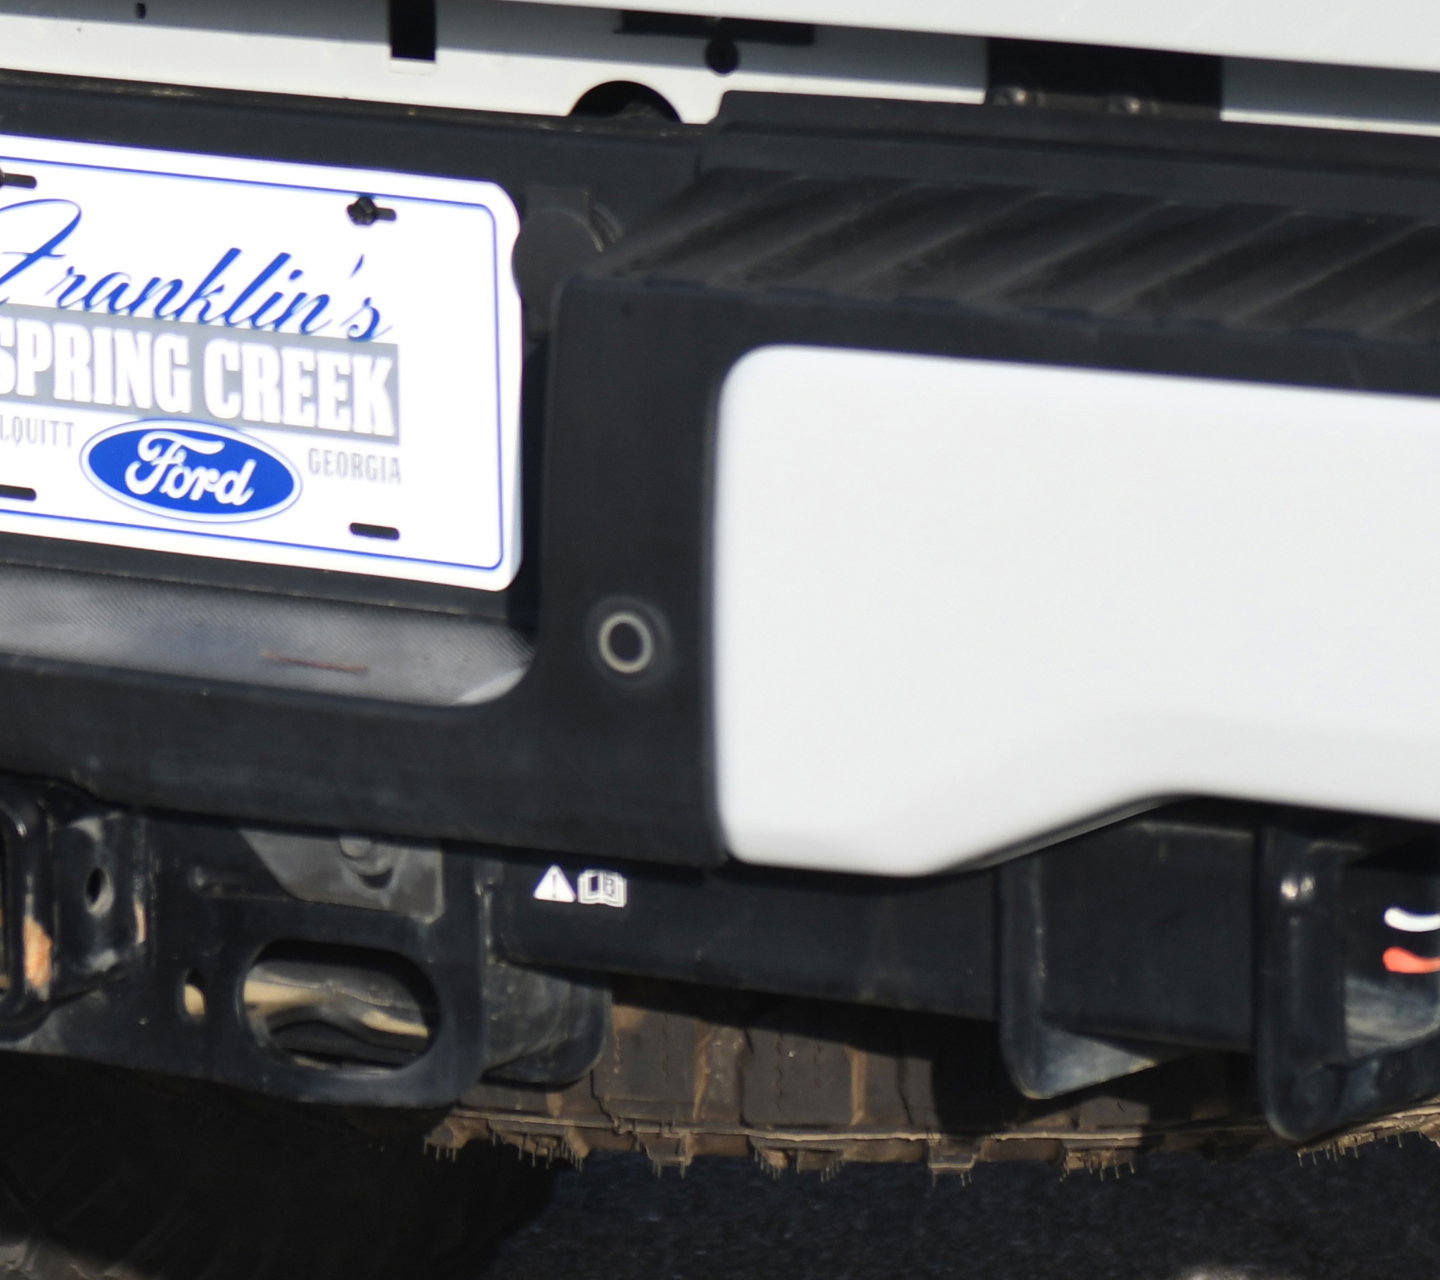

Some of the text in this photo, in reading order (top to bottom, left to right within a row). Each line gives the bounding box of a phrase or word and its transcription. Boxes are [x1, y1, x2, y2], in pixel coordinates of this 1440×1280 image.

[203, 338, 396, 437] CREEK
[125, 430, 257, 507] Ford
[308, 447, 402, 485] GEORGIA
